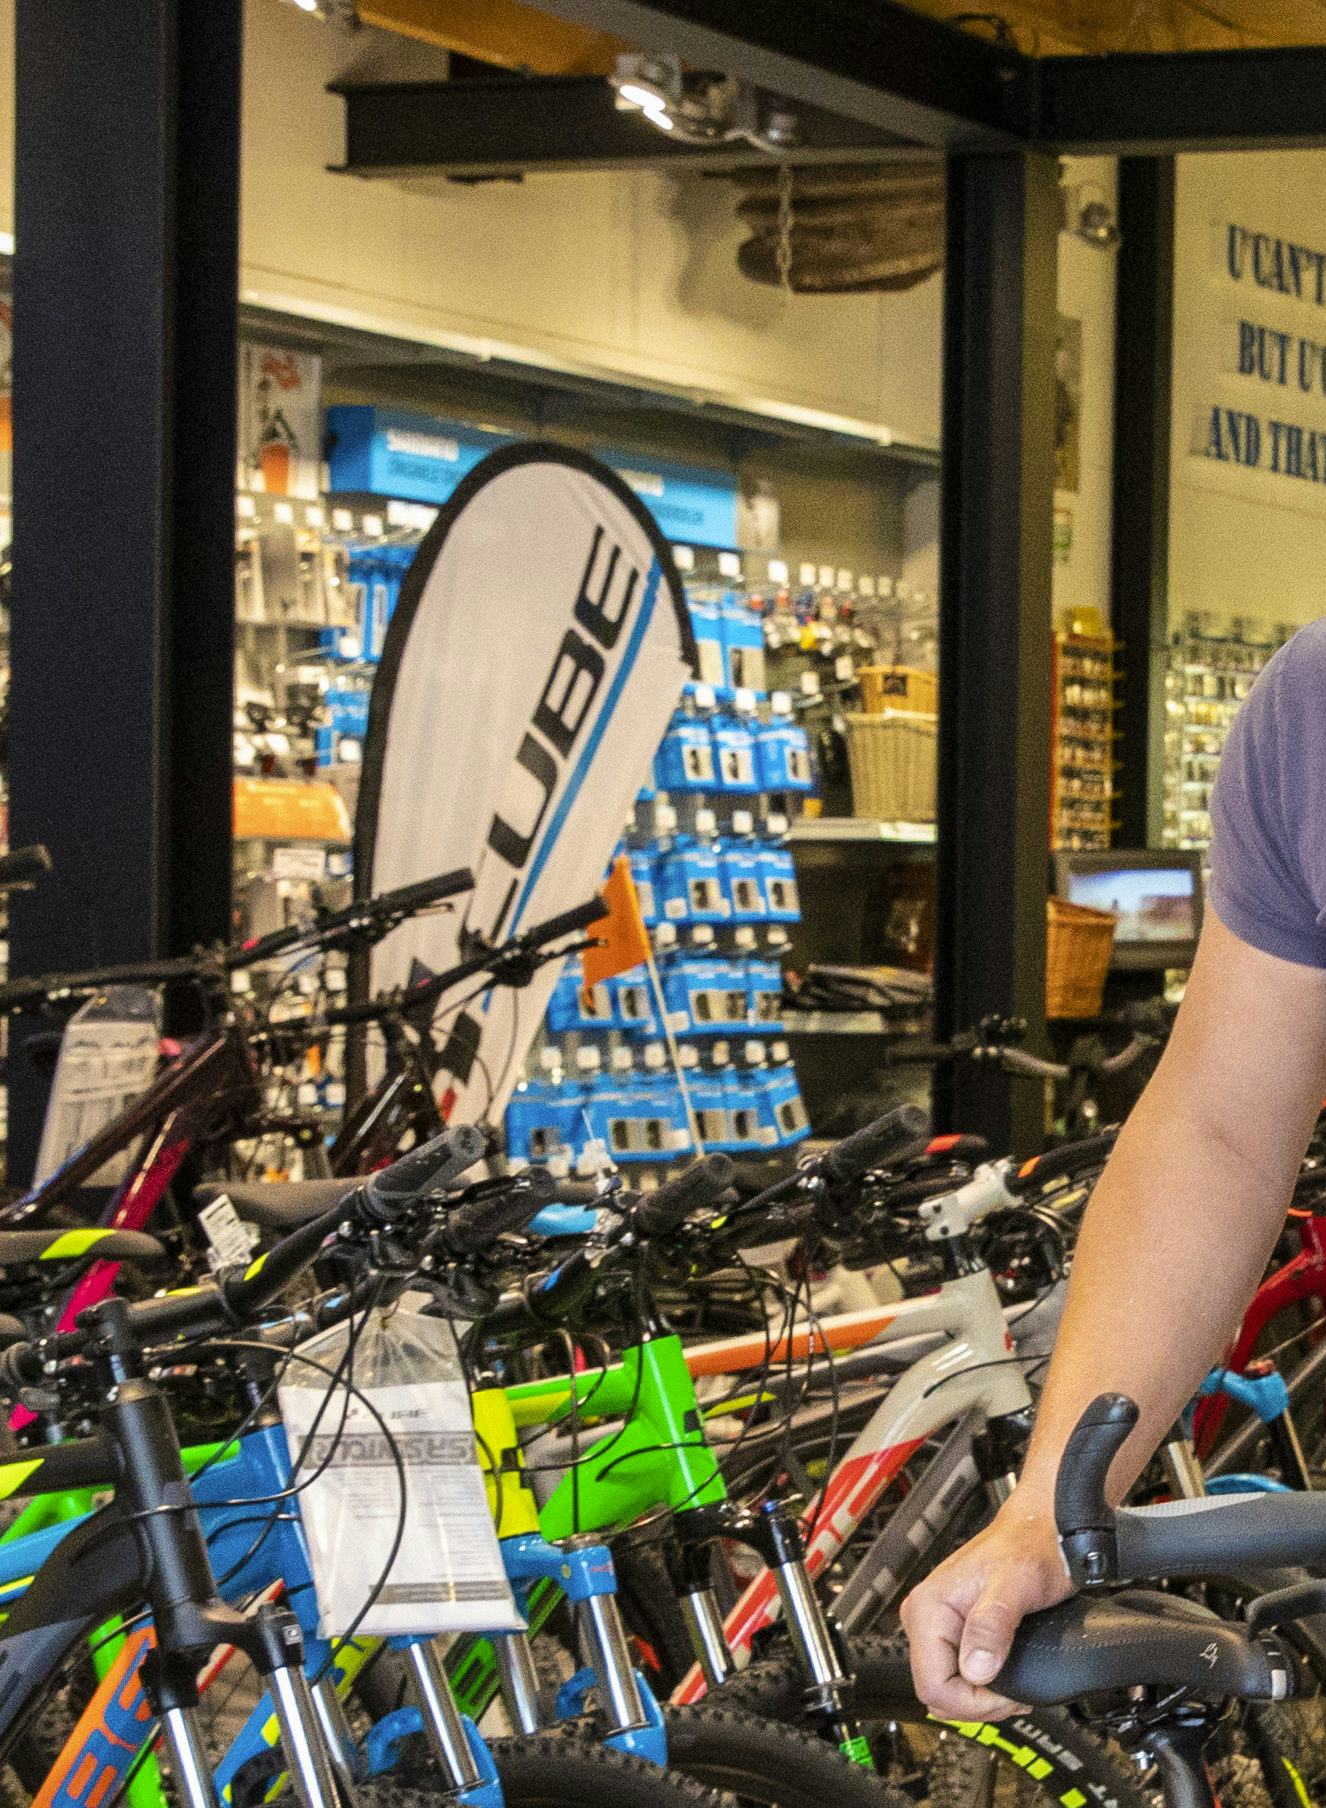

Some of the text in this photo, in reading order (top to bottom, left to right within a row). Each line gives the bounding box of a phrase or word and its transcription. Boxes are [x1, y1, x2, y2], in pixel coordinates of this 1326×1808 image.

[1226, 224, 1248, 280] U
[1238, 320, 1292, 386] BUT
[1297, 338, 1319, 393] U
[1204, 405, 1262, 468] AND
